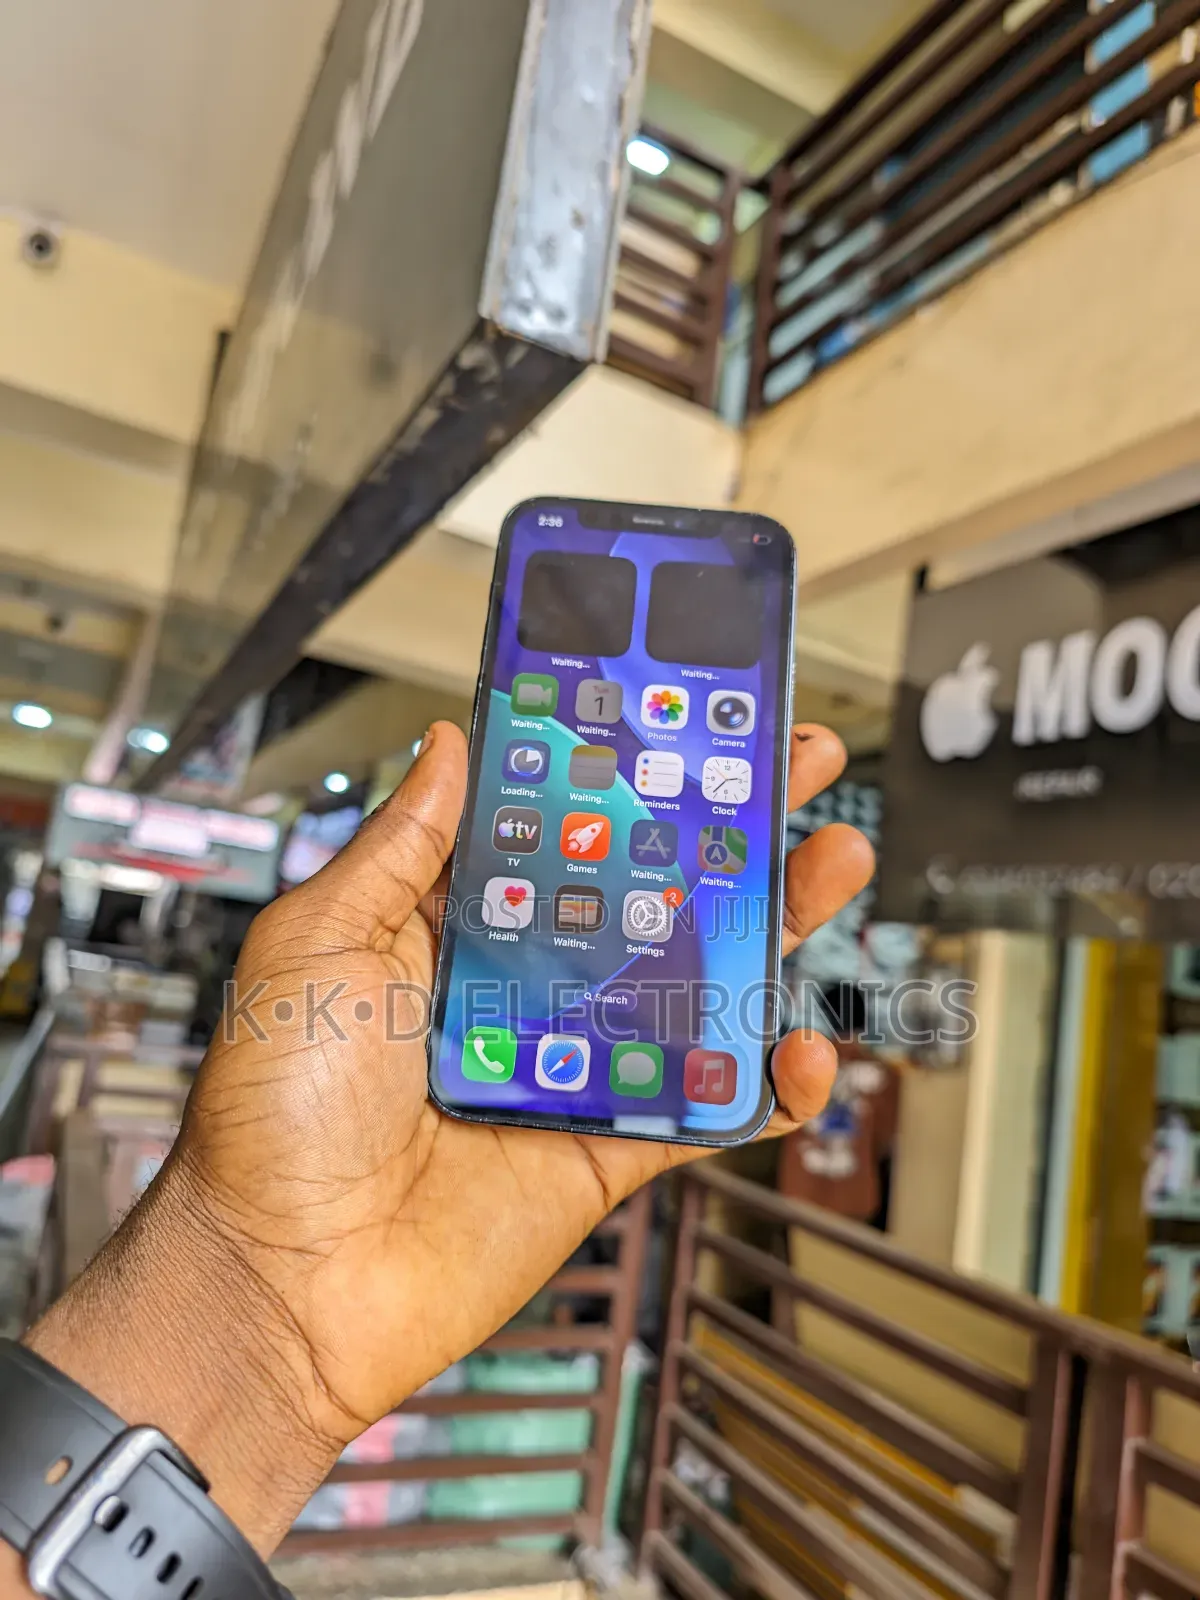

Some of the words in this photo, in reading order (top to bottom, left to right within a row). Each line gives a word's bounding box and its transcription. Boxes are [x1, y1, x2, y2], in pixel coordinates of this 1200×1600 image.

[537, 512, 564, 528] 2:36
[551, 656, 591, 669] Waiting...
[680, 669, 720, 681] Waiting...
[594, 696, 604, 717] 1
[510, 718, 550, 731] Waiting...
[576, 725, 616, 737] Waiting...
[647, 731, 677, 742] Photos
[711, 737, 746, 748] Camera
[500, 786, 544, 798] Loading...
[569, 792, 610, 804] Waiting...
[633, 799, 681, 811] Reminders
[711, 805, 738, 816] Clock
[515, 821, 538, 840] tv
[507, 857, 521, 867] TV
[566, 863, 598, 874] Games
[630, 869, 672, 882] Waiting...
[699, 876, 742, 889] Waiting...
[488, 930, 519, 942] Health
[553, 936, 596, 950] Waiting...
[625, 944, 665, 957] Settings
[595, 993, 629, 1005] Search
